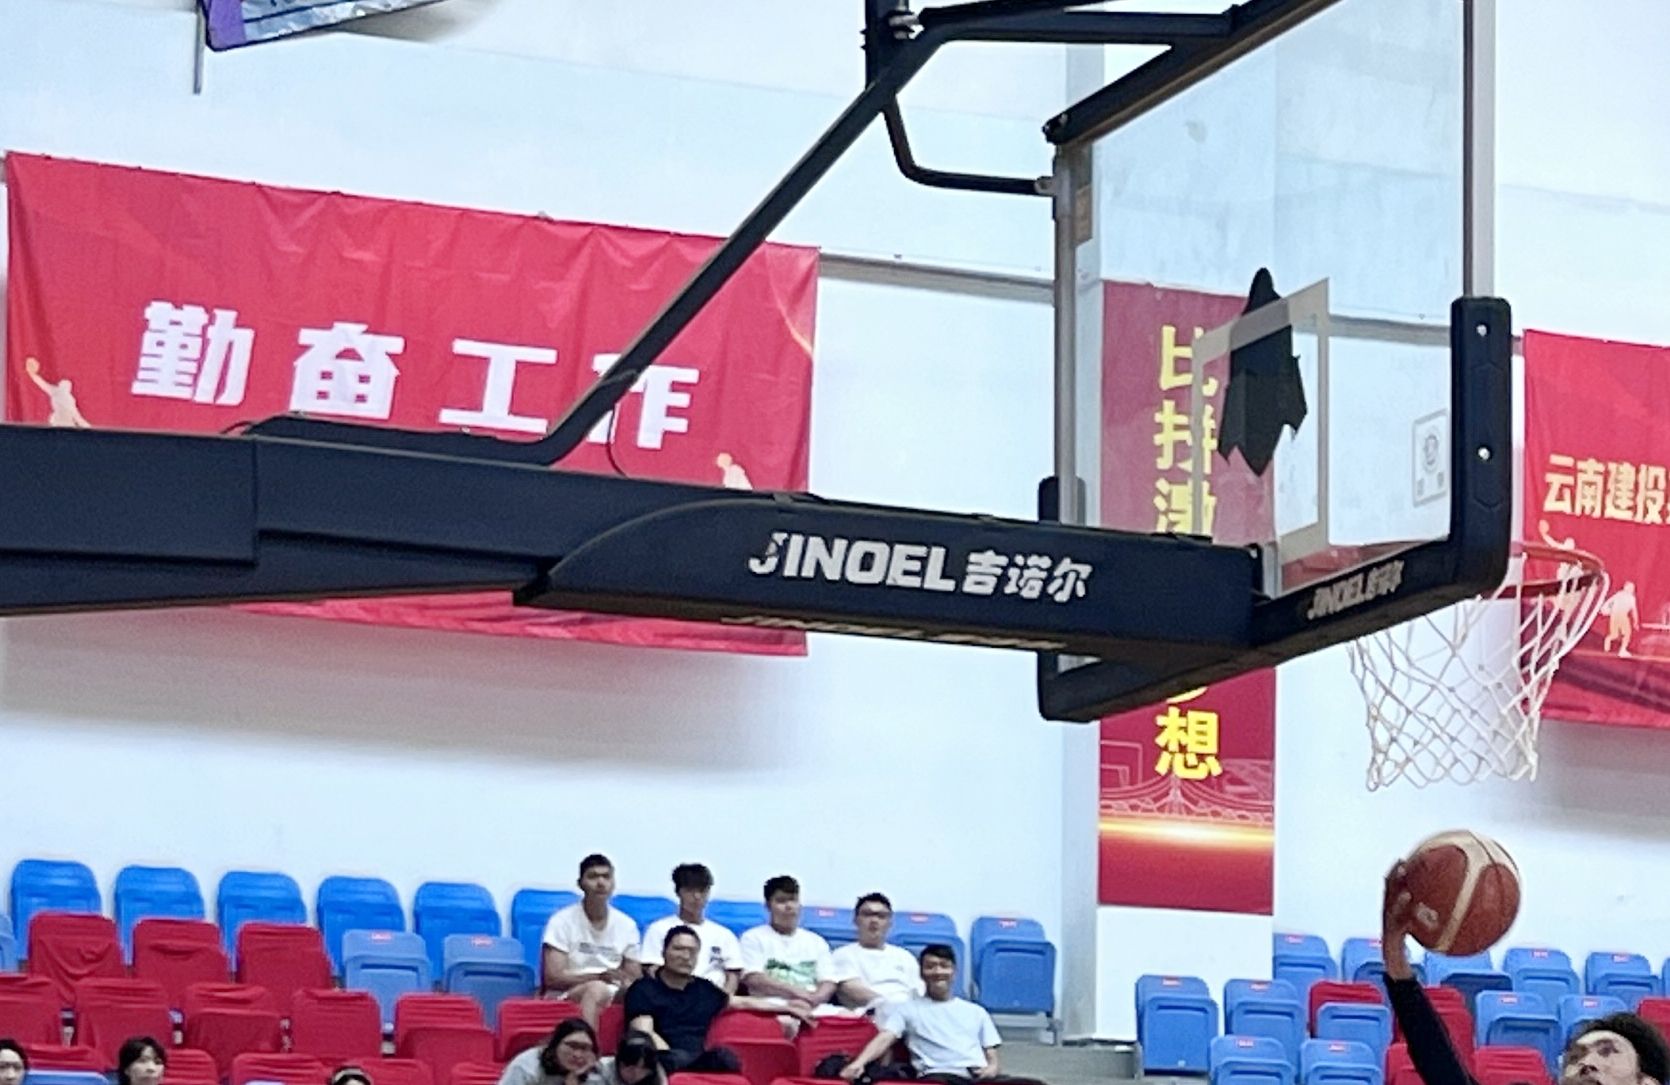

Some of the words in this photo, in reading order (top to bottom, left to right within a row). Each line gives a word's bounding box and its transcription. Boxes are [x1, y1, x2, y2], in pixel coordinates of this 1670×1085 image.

[131, 300, 700, 449] 勤奋工作
[749, 531, 956, 592] JINOEL
[962, 550, 1094, 602] 吉诺尔
